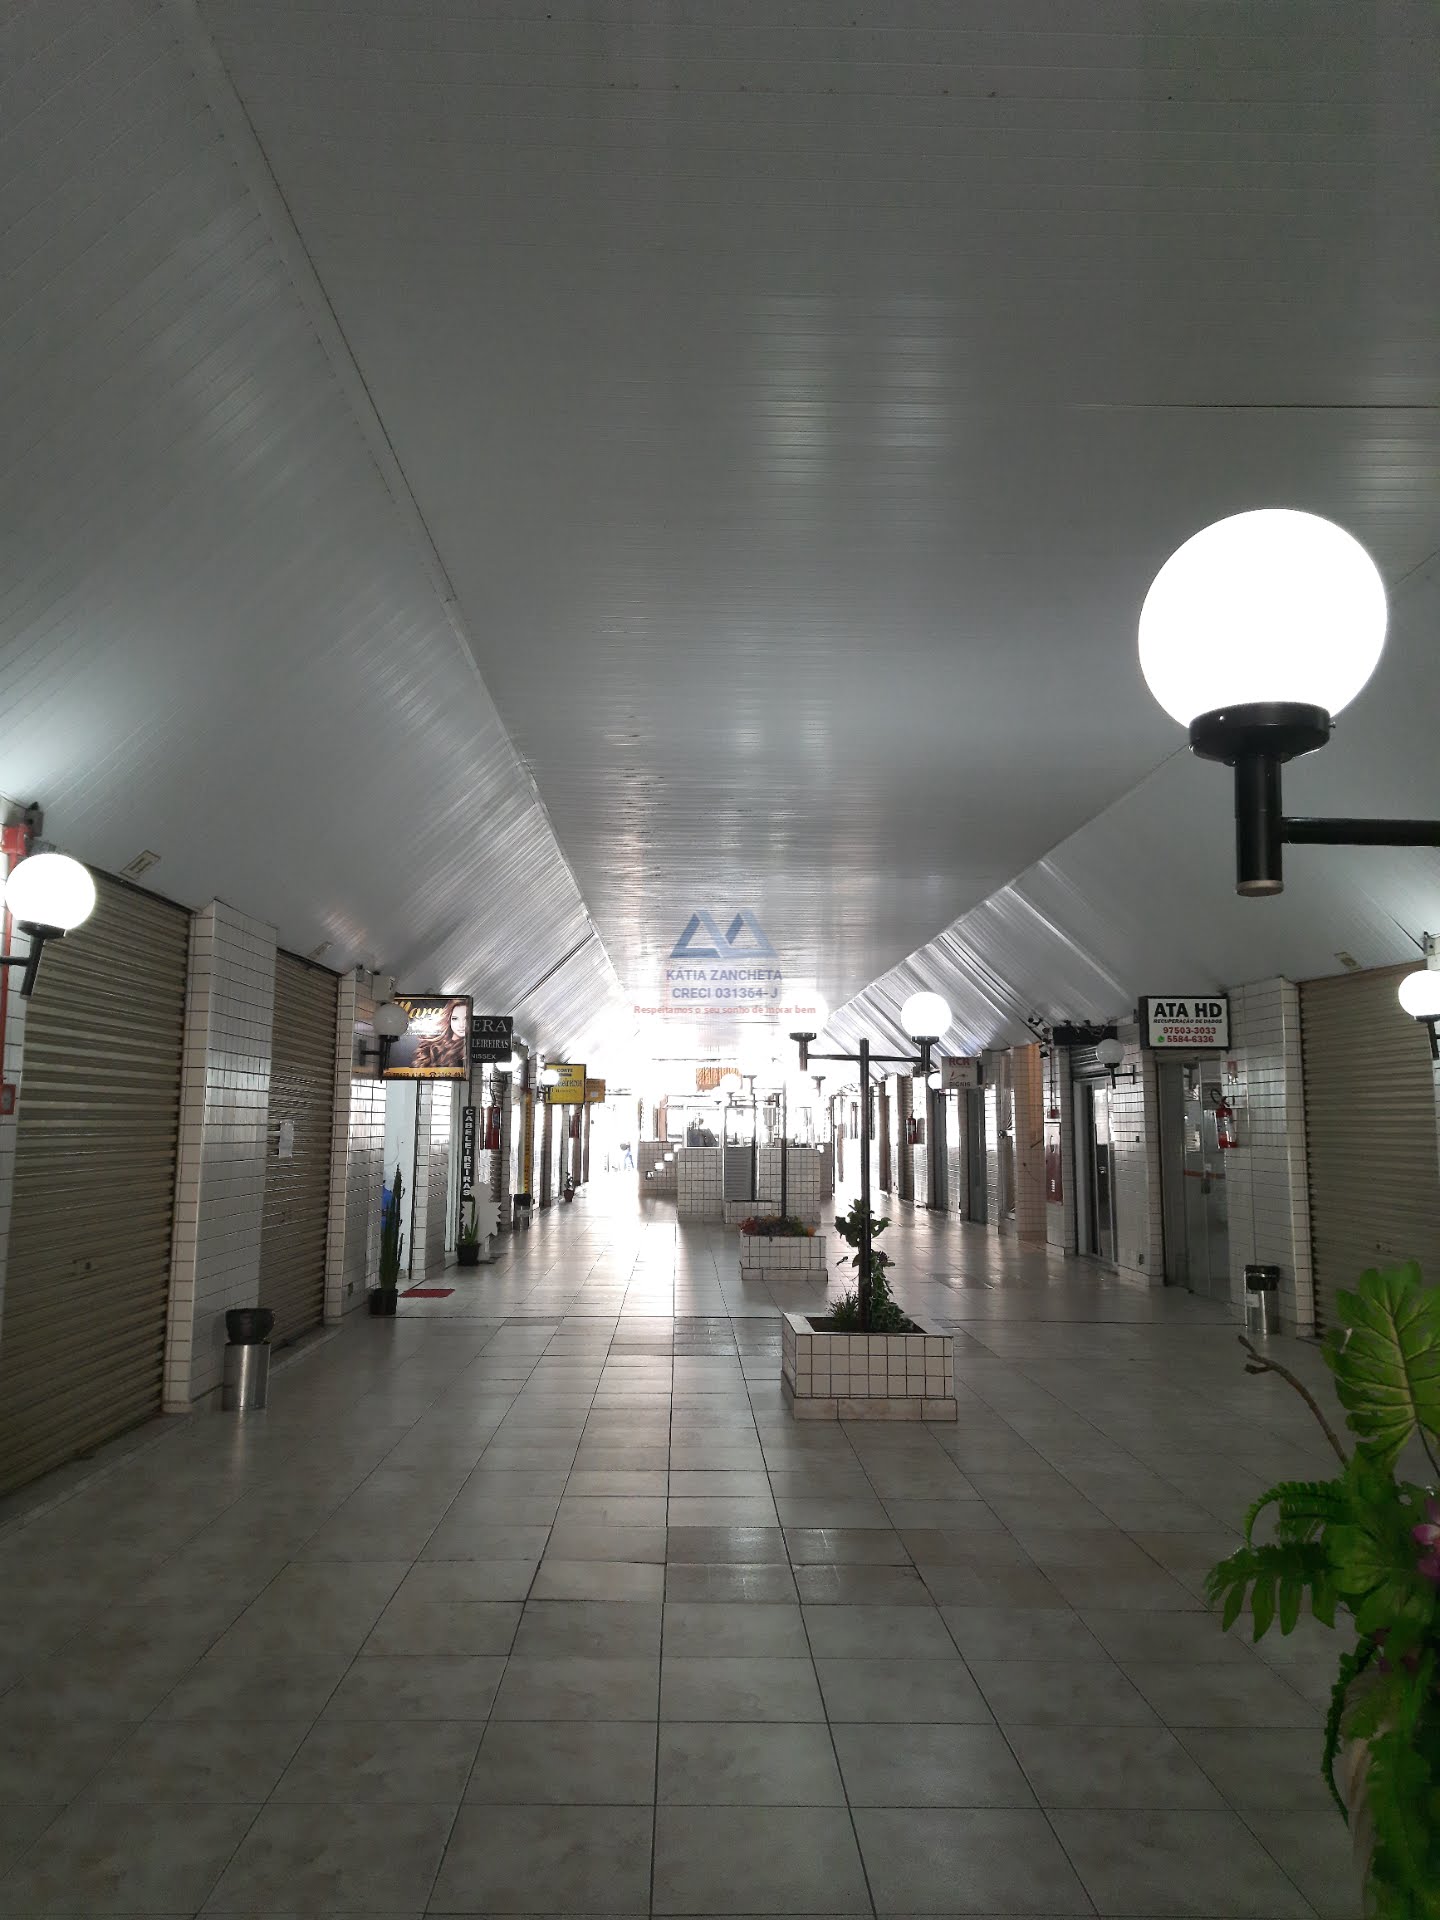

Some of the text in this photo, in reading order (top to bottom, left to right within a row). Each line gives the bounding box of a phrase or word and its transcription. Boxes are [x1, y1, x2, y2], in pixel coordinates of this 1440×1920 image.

[1154, 1002, 1223, 1018] ATA HD
[1163, 1026, 1217, 1035] 97503-3033
[463, 1108, 475, 1196] CABELEIREIRAS
